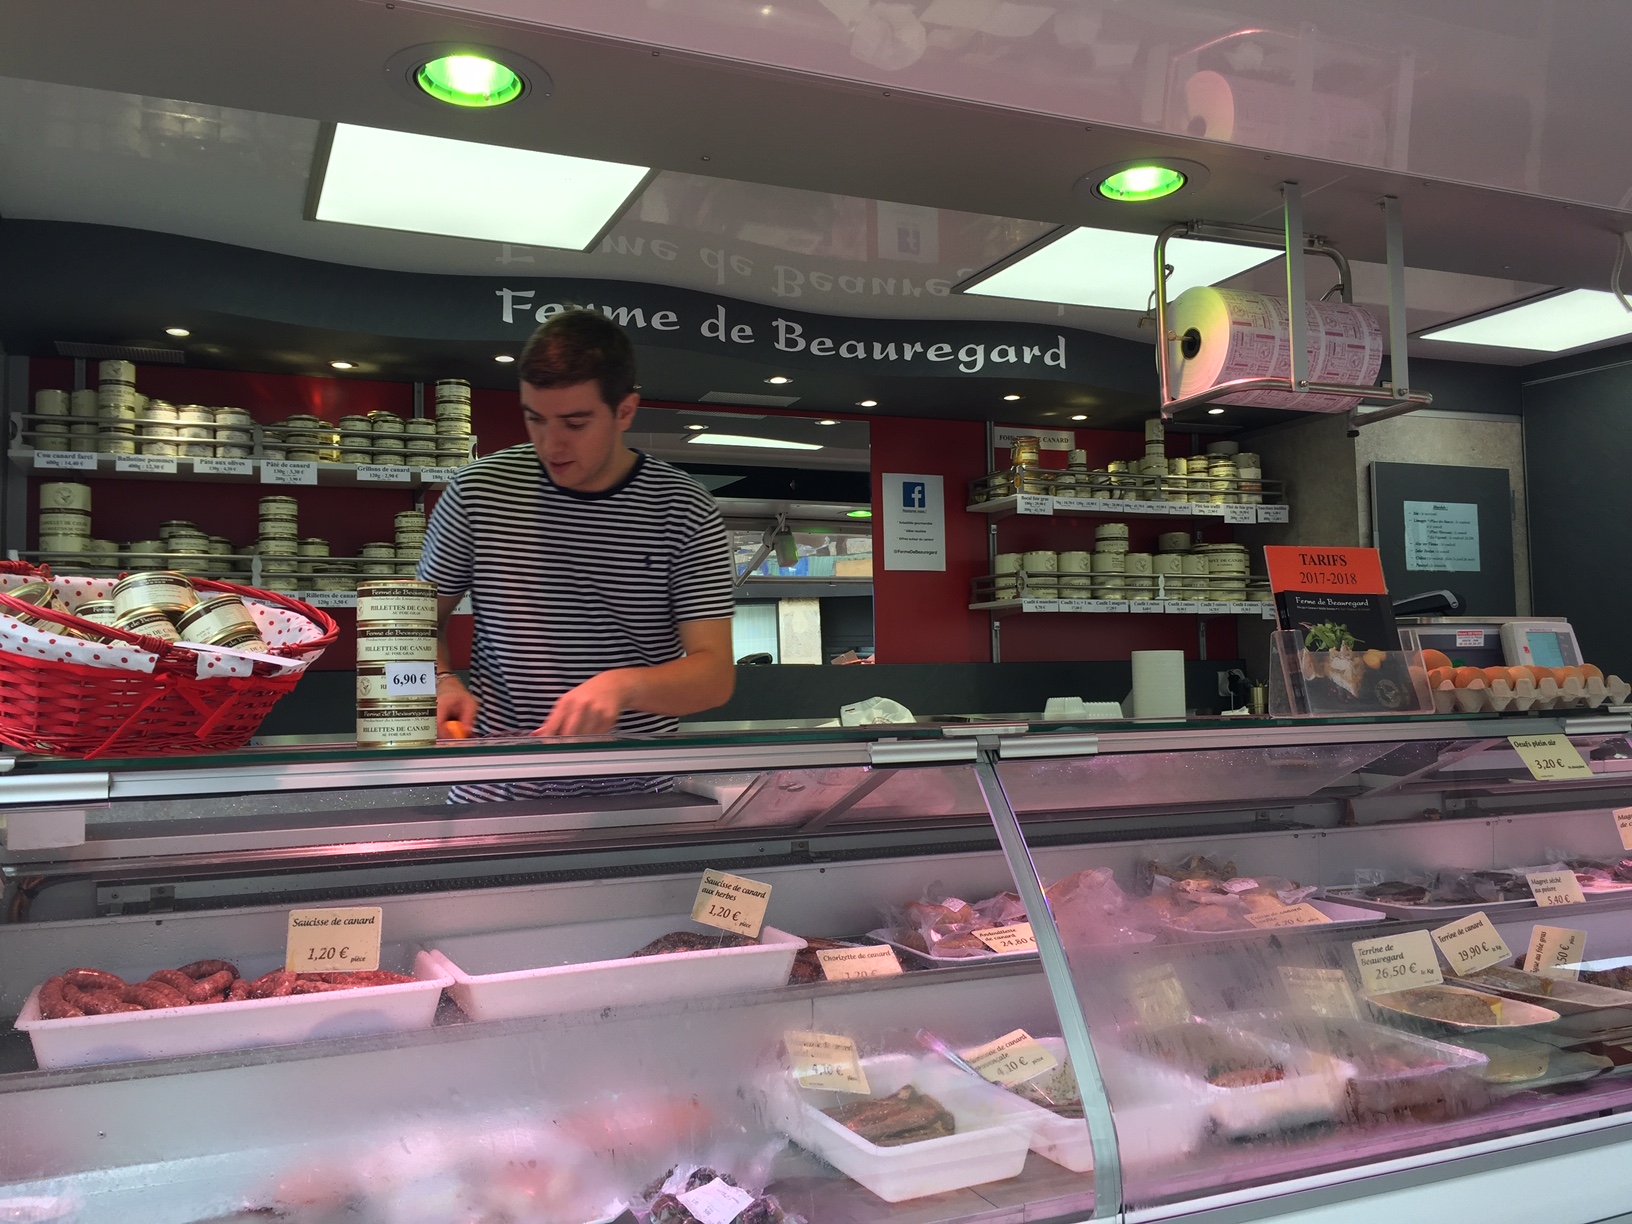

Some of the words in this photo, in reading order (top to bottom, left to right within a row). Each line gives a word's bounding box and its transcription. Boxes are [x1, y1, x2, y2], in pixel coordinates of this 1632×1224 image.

[495, 287, 681, 331] Feme
[700, 304, 755, 343] de
[771, 317, 1067, 374] Beauregard
[1043, 436, 1069, 444] CANARD
[36, 452, 51, 460] Cou
[117, 455, 147, 463] Ballotine
[147, 457, 175, 465] pommes
[357, 465, 381, 473] Grillons
[1298, 553, 1348, 567] TARIFS
[1299, 571, 1358, 585] 2017-2018
[306, 592, 330, 600] Rillettes
[1295, 596, 1316, 605] Ferme
[1326, 598, 1369, 608] Beauregard
[317, 599, 332, 607] 120g
[130, 619, 141, 631] de
[152, 627, 162, 637] DE
[394, 629, 431, 638] Beauregard
[392, 673, 417, 688] 6,90
[419, 673, 427, 685] €
[392, 709, 430, 718] Beauregard
[1513, 740, 1532, 748] Oeufs
[1531, 739, 1548, 748] plein
[1534, 759, 1556, 770] 3,20
[1556, 758, 1565, 768] €
[1619, 821, 1628, 829] de
[1531, 877, 1548, 886] Magret
[1548, 876, 1562, 884] séché
[704, 876, 733, 890] Saucisse
[732, 884, 742, 893] de
[741, 887, 767, 899] canard
[1541, 886, 1557, 895] poivre
[701, 887, 715, 896] aux
[714, 889, 737, 902] herbes
[1547, 894, 1564, 906] 5,40
[1564, 894, 1571, 904] €
[708, 904, 732, 919] 1,20
[732, 910, 742, 922] €
[738, 921, 752, 929] pièce
[1279, 906, 1303, 915] canard
[292, 917, 329, 928] Saucisse
[330, 917, 342, 926] de
[343, 915, 376, 926] canard
[1274, 918, 1295, 927] 470
[993, 933, 1017, 941] canard
[1437, 931, 1458, 944] Terrine
[1457, 928, 1465, 938] de
[1464, 920, 1484, 935] canard
[1539, 931, 1547, 944] gras
[1000, 937, 1028, 948] 24,80
[1535, 943, 1544, 954] foie
[1559, 943, 1570, 951] €
[307, 947, 336, 961] 1,20
[339, 946, 350, 959] €
[350, 956, 367, 964] pièce
[1358, 946, 1384, 956] Terrine
[1384, 944, 1395, 952] de
[1457, 945, 1482, 962] 19,90
[1481, 941, 1490, 953] €
[822, 954, 857, 963] Chorizette
[857, 952, 866, 960] de
[866, 950, 892, 959] canard
[1360, 951, 1405, 967] Beauregard
[1375, 964, 1407, 980] 26,50
[1408, 962, 1418, 974] €
[1426, 968, 1434, 976] Kg
[996, 1045, 1006, 1053] de
[1005, 1033, 1028, 1048] canard
[1018, 1056, 1029, 1067] €
